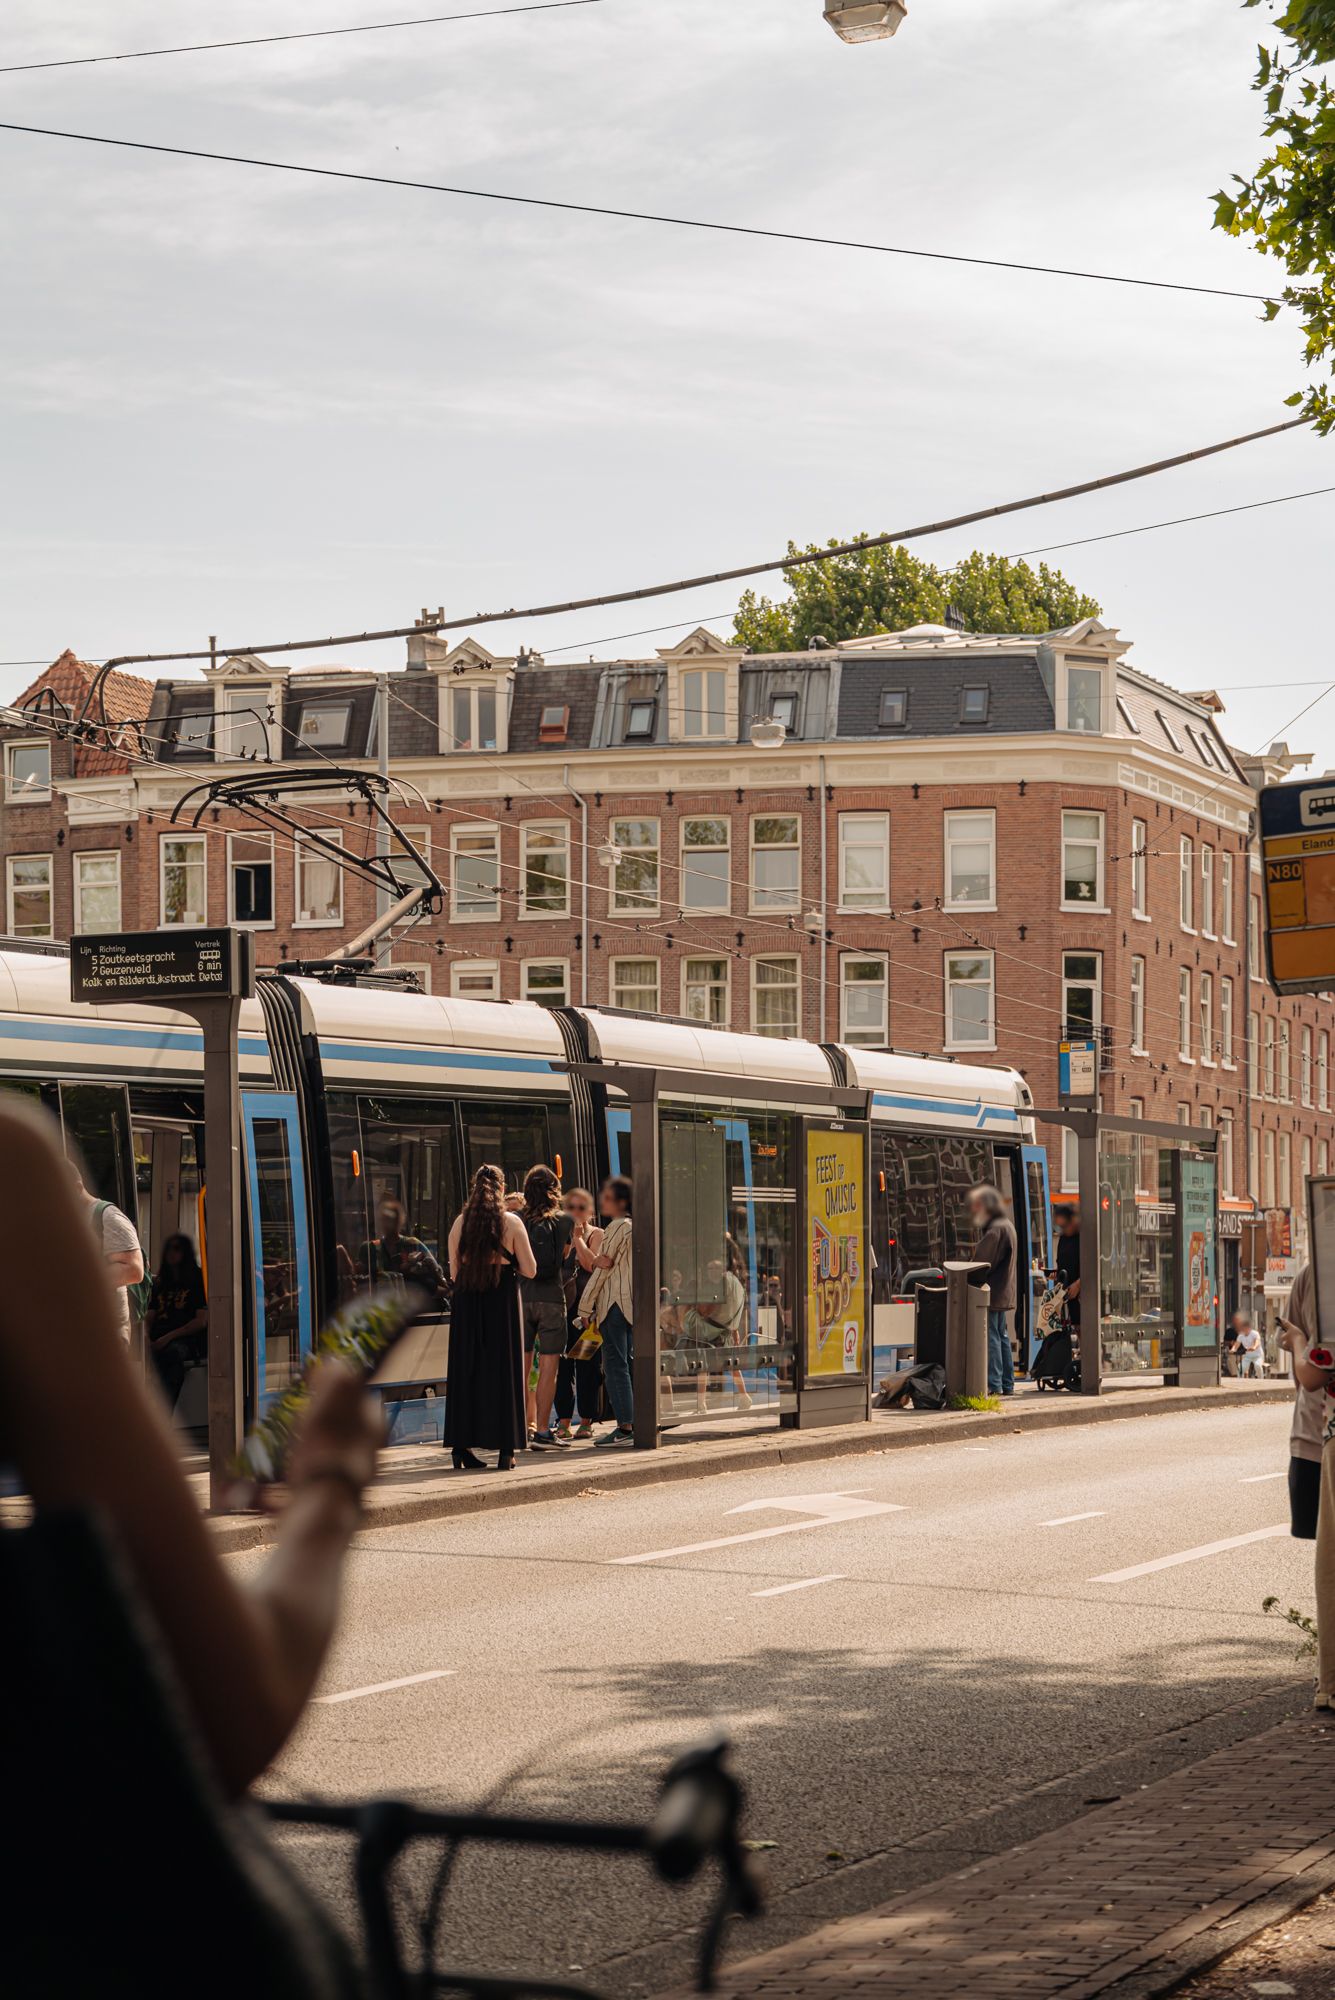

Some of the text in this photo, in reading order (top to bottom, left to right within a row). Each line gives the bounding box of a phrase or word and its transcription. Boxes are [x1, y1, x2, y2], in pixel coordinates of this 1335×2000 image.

[1270, 864, 1301, 880] N80
[80, 940, 220, 956] Lijn Richting Vertrek
[92, 951, 176, 965] 5 Zoutkeetsgracht
[92, 961, 222, 976] 7 Geuzenveld 6 min
[105, 978, 117, 986] en
[816, 1154, 845, 1185] FEEST OP
[825, 1182, 857, 1219] QMUSIC
[1222, 1214, 1237, 1234] AND
[812, 1235, 859, 1292] FOUTE
[817, 1272, 851, 1326] 1500
